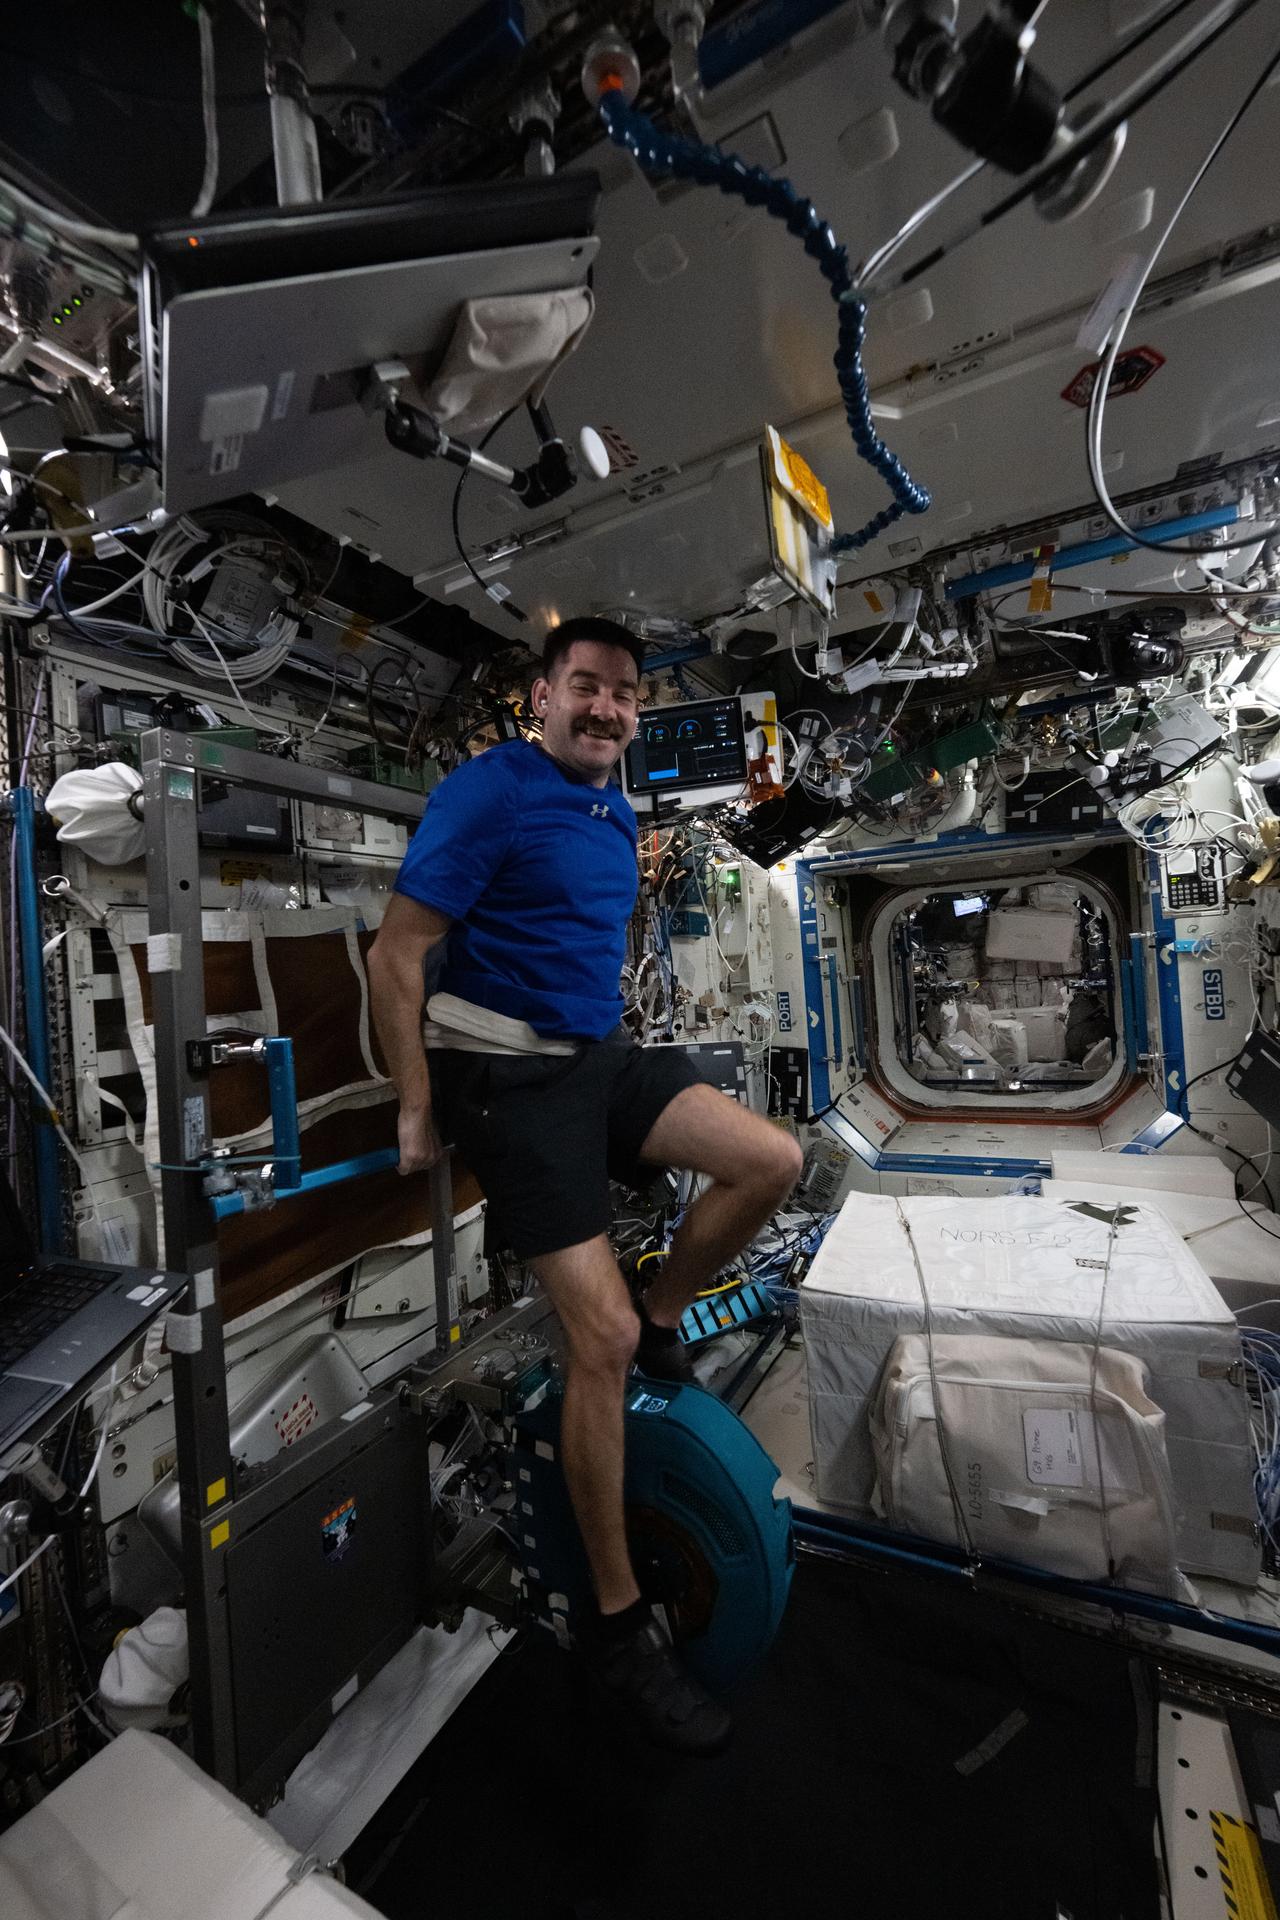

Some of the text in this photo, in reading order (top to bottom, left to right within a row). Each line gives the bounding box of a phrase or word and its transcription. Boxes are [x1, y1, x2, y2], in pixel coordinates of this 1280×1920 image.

[778, 993, 791, 1030] PORT
[1204, 972, 1224, 1018] STBD
[939, 1227, 1016, 1245] NORS
